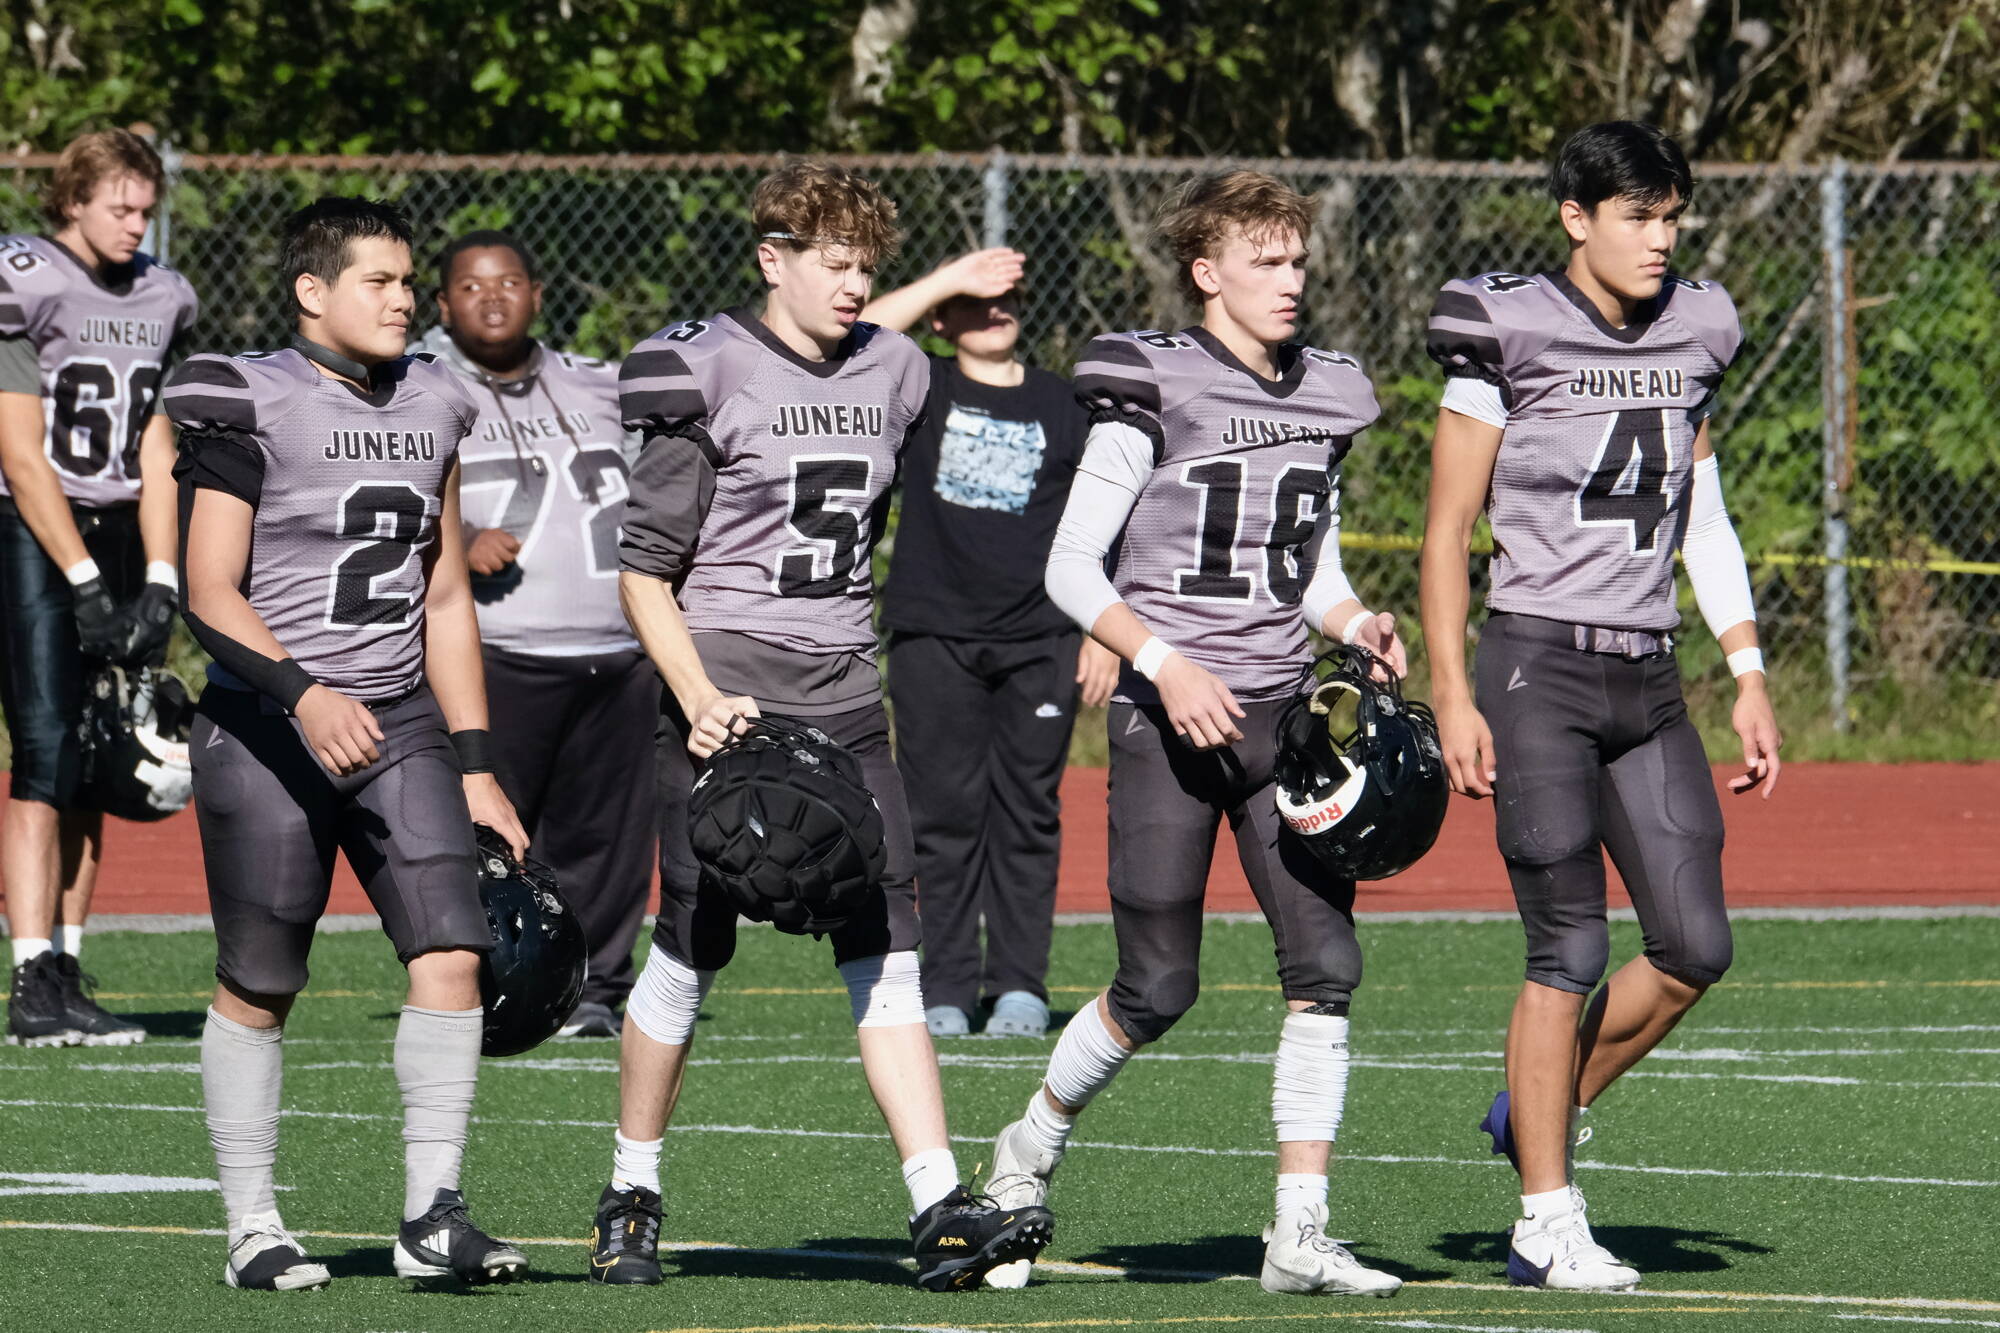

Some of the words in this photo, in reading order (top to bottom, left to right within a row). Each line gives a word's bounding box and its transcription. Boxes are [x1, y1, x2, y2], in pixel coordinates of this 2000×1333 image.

[79, 318, 164, 347] JUNEAU
[1567, 367, 1684, 400] JUNEAU
[770, 404, 884, 438] JUNEAU
[1221, 416, 1331, 447] JUNEAU
[324, 429, 435, 462] JUNEAU
[1573, 409, 1674, 557] 4
[461, 443, 630, 579] 72
[771, 453, 874, 599] 5
[1173, 456, 1332, 608] 16
[323, 480, 432, 630] 2
[938, 1236, 968, 1247] ALPHA
